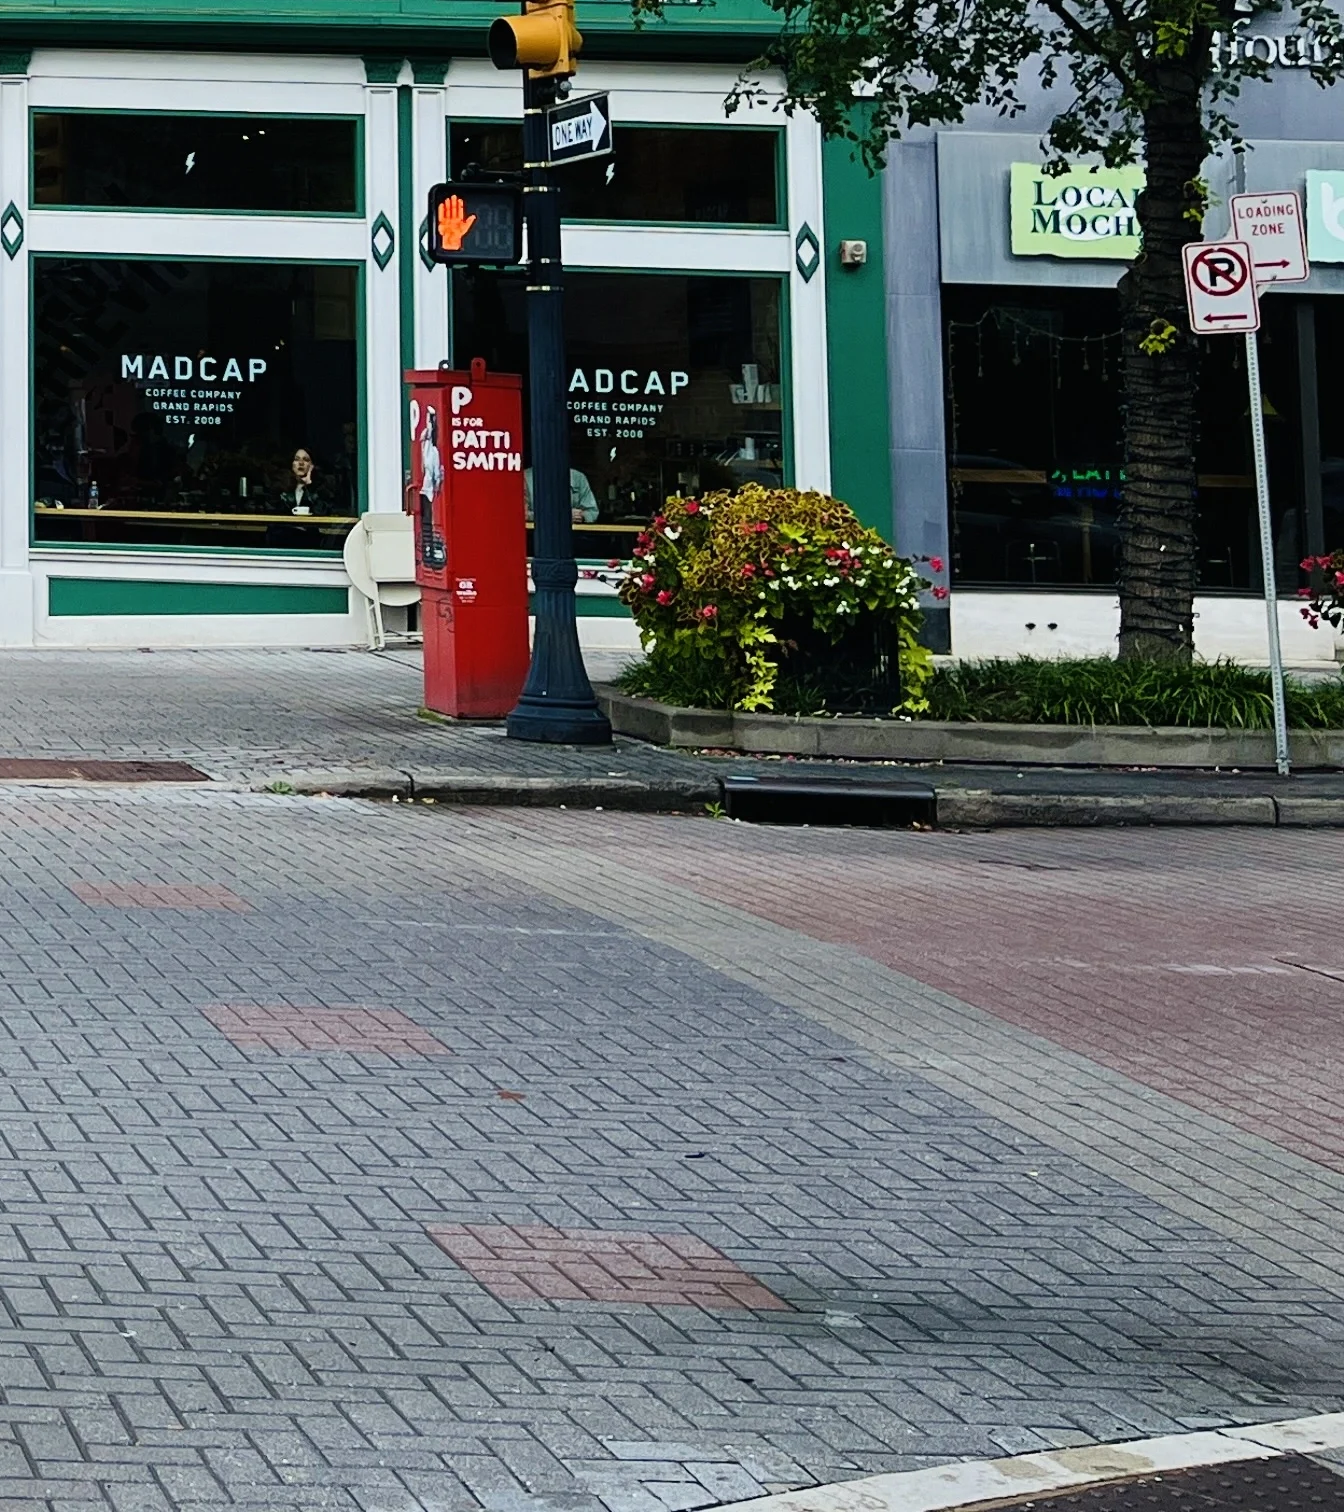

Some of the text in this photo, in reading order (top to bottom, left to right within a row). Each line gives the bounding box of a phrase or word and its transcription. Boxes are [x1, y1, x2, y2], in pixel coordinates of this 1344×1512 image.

[555, 116, 592, 146] ONE WAY
[1238, 204, 1294, 219] LOADING
[1030, 208, 1142, 237] MOCH
[1251, 222, 1285, 236] ZONE
[121, 354, 267, 383] MADCAP
[568, 368, 689, 396] ADCAP
[145, 388, 242, 400] COFFEE COMPANY
[451, 386, 473, 415] P
[153, 401, 234, 412] GRAND RAPIDS
[566, 401, 664, 413] COFFEE COMPANY
[194, 416, 222, 425] 2008
[410, 399, 420, 441] P
[452, 417, 484, 427] IS FOR
[573, 414, 656, 426] GRAND RAPIDS
[452, 429, 511, 450] PATTI
[616, 429, 644, 438] 2008
[452, 451, 522, 472] SMITH
